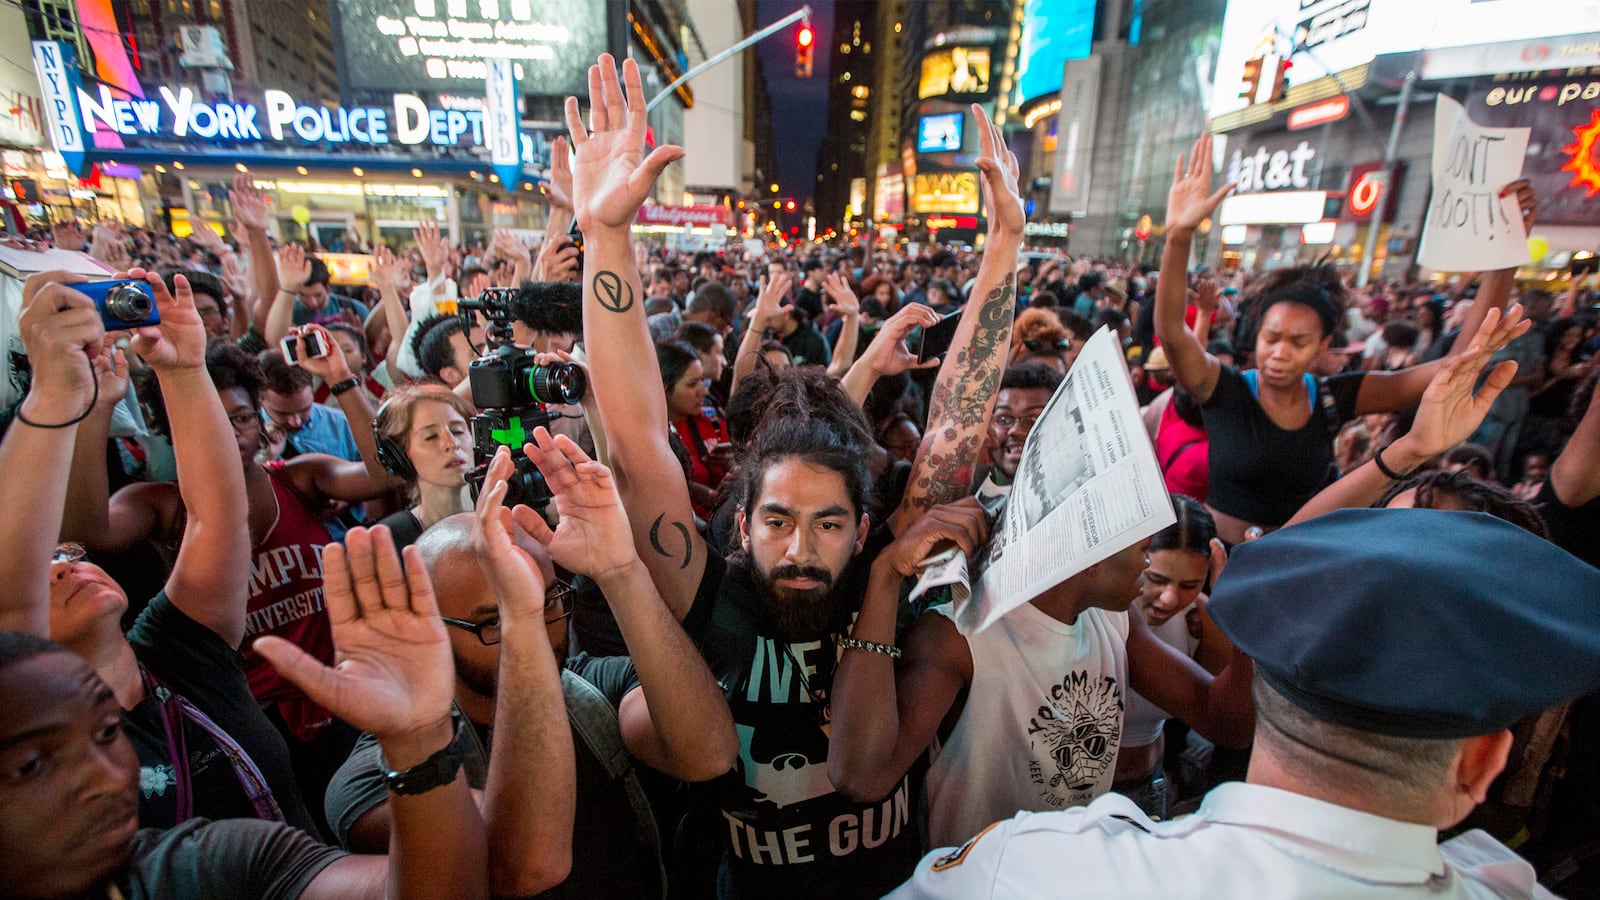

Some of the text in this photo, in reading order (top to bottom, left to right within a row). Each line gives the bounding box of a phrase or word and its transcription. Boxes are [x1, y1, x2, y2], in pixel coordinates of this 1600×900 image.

[40, 46, 75, 146] NYPD
[76, 84, 160, 135] NEW
[159, 86, 262, 139] YORK
[265, 90, 389, 144] POLICE
[393, 94, 483, 146] DEPT
[1025, 222, 1068, 237] CHASE
[1081, 488, 1092, 513] WORLD
[1086, 511, 1100, 545] WORKERS
[1028, 760, 1044, 785] KEEP
[721, 772, 910, 866] THE GUN
